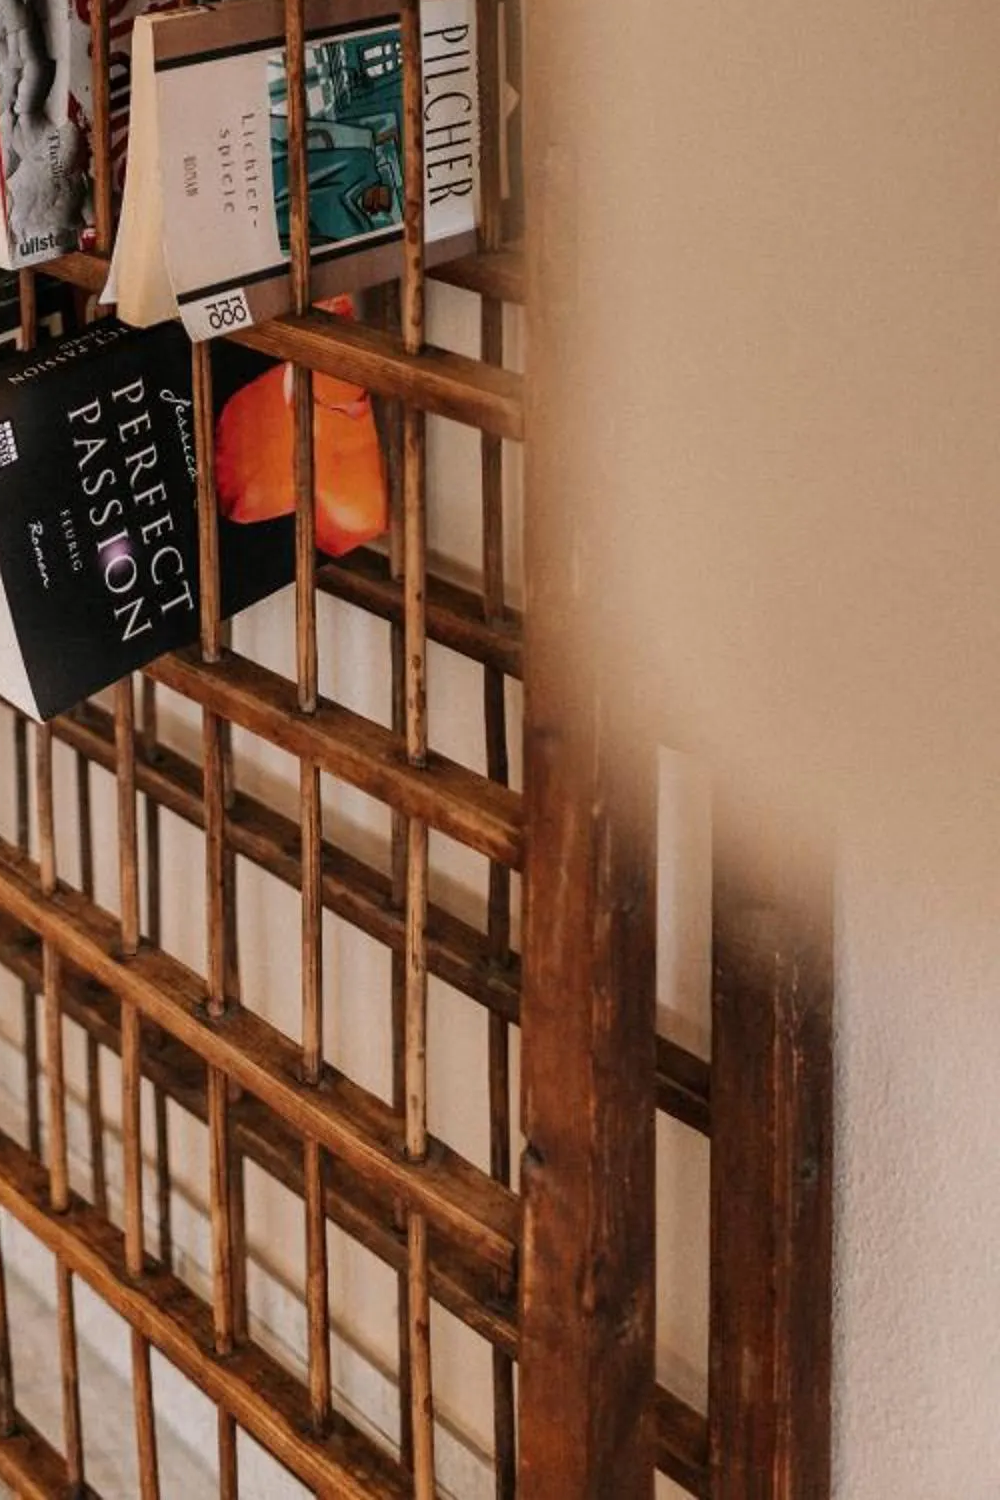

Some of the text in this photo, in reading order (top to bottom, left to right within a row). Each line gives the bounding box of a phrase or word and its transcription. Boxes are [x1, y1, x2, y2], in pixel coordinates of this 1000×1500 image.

[424, 23, 475, 207] PILCHER
[27, 520, 52, 590] Roman
[59, 508, 82, 574] FEURIG
[67, 396, 153, 644] PASSION
[111, 376, 195, 616] PERFECT
